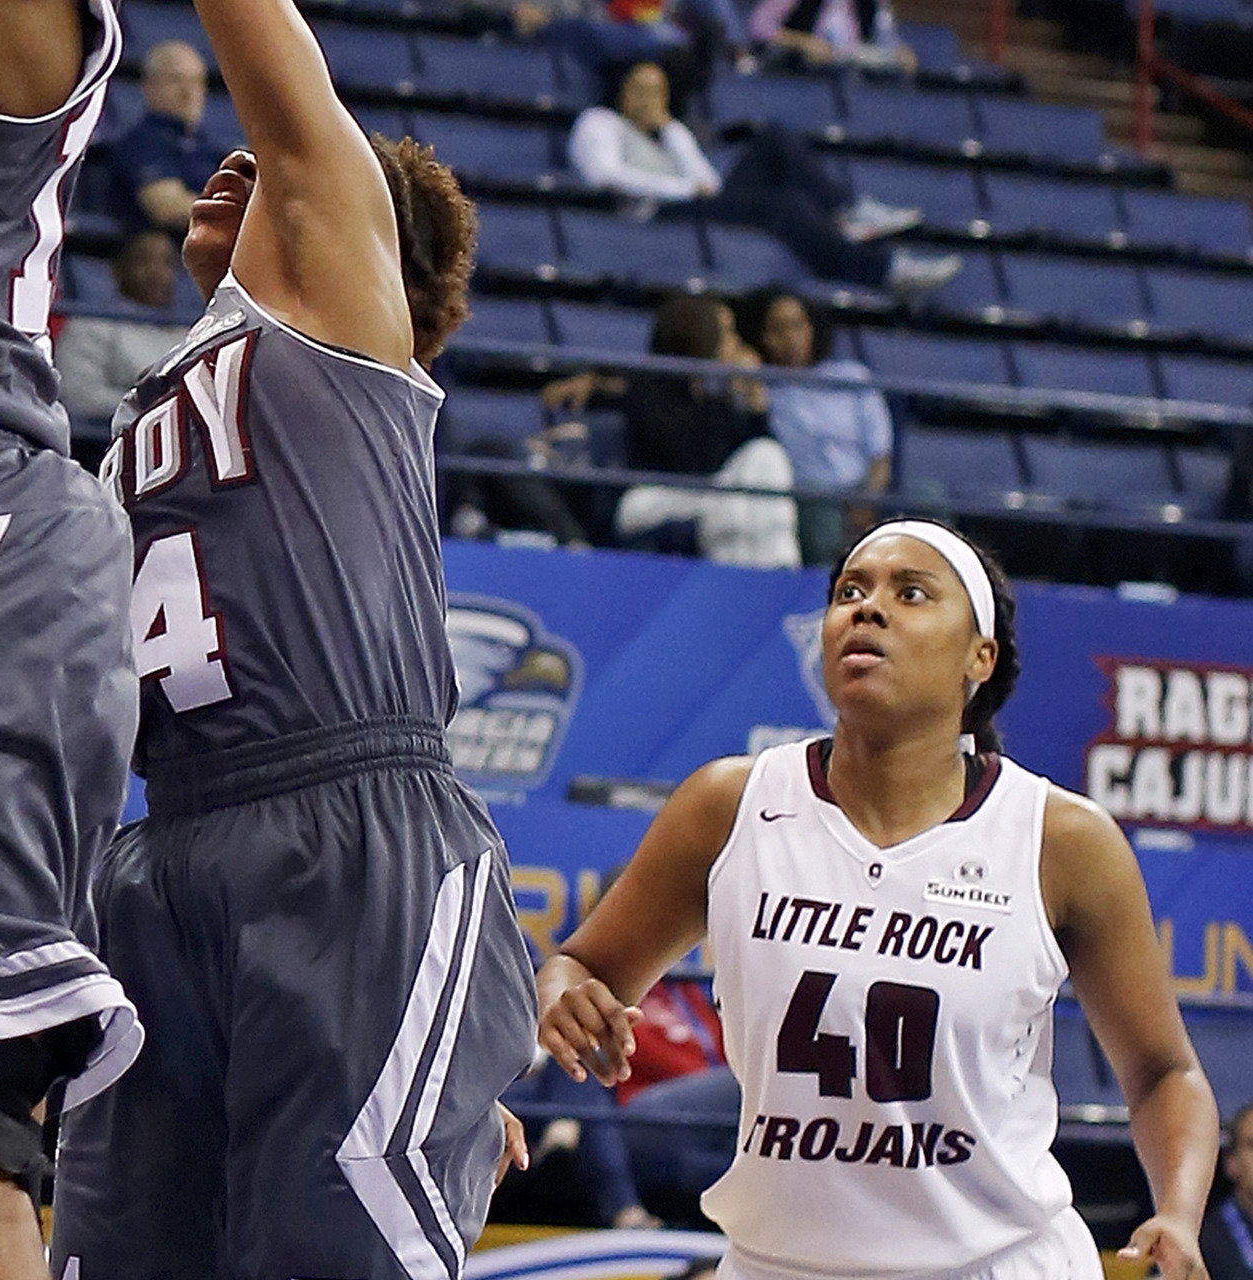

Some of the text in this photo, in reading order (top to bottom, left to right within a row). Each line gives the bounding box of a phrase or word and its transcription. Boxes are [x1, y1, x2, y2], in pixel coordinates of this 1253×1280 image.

[750, 891, 996, 972] LITTLE ROCK
[776, 969, 942, 1104] 40
[743, 1114, 978, 1169] TROJANS
